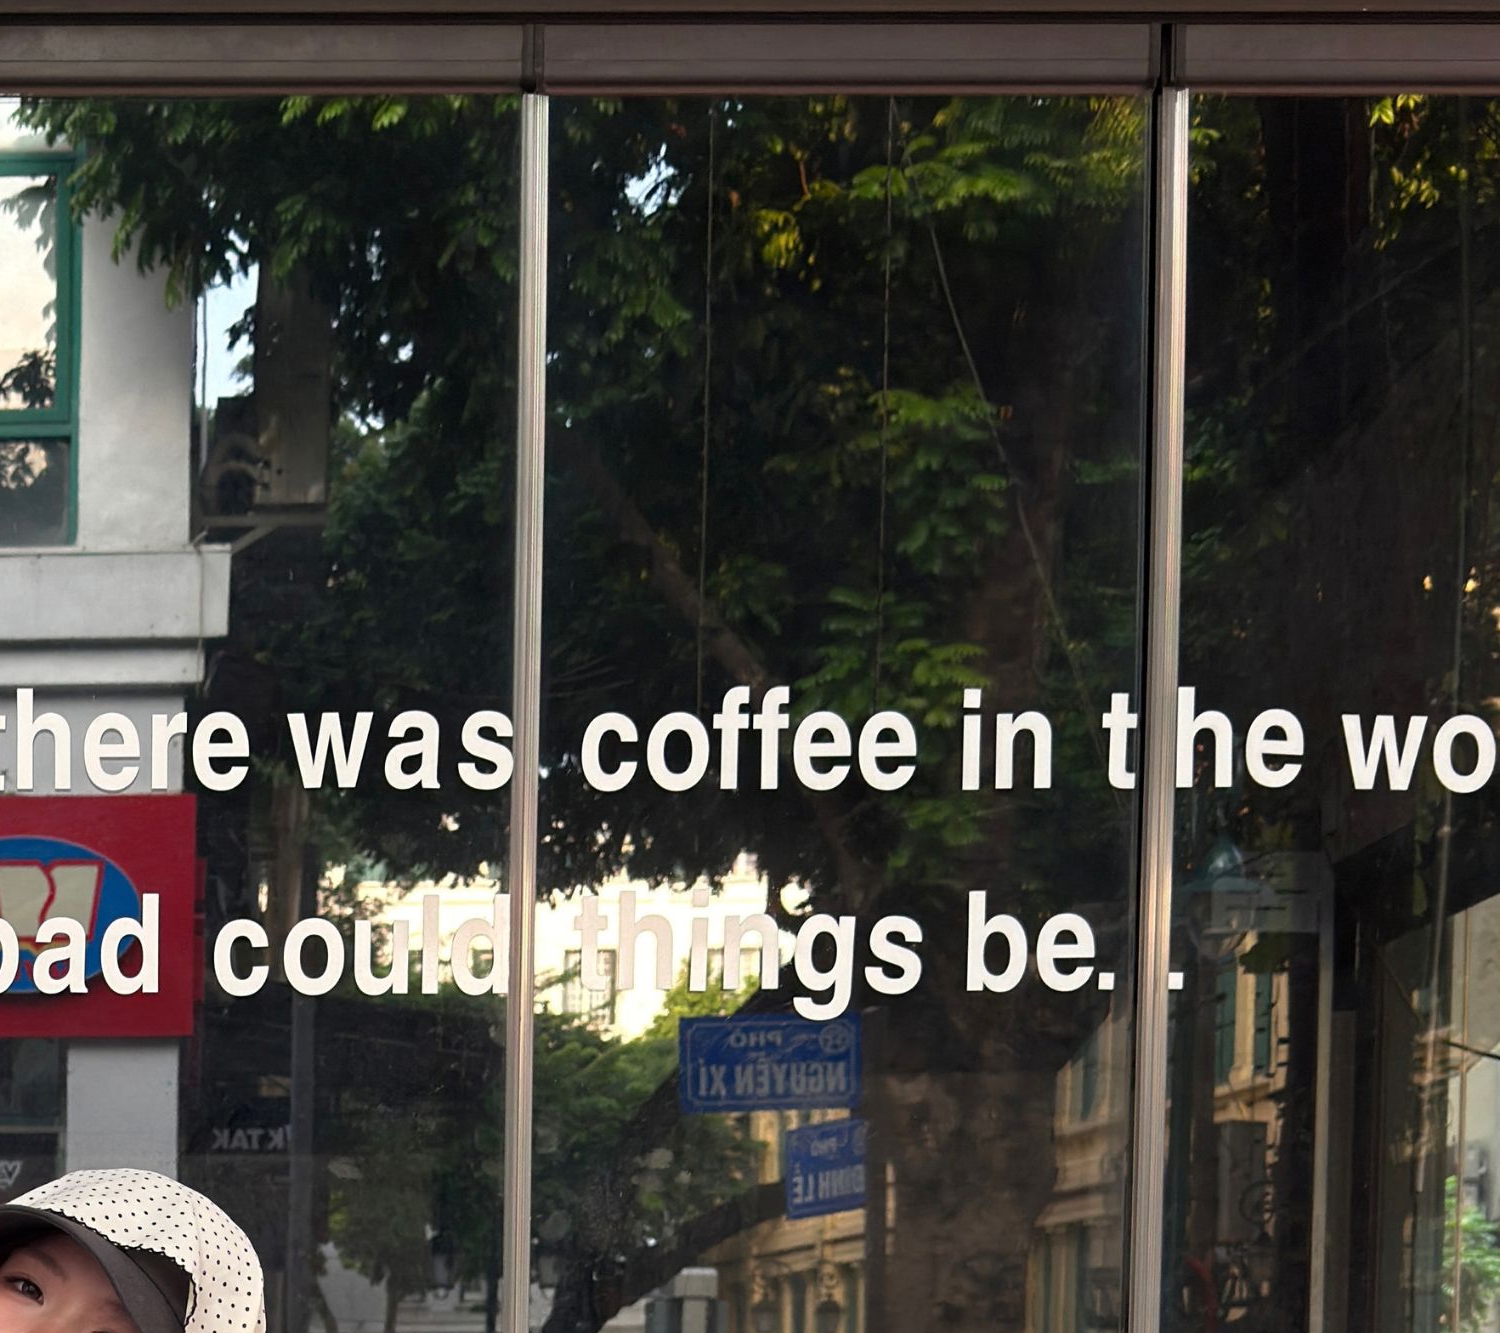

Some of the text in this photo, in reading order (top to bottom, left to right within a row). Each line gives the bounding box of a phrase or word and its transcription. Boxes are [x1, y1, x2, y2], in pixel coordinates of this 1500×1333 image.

[286, 709, 514, 792] was
[580, 686, 917, 792] coffee
[961, 688, 1052, 791] in
[212, 893, 511, 997] could
[573, 889, 924, 1022] things
